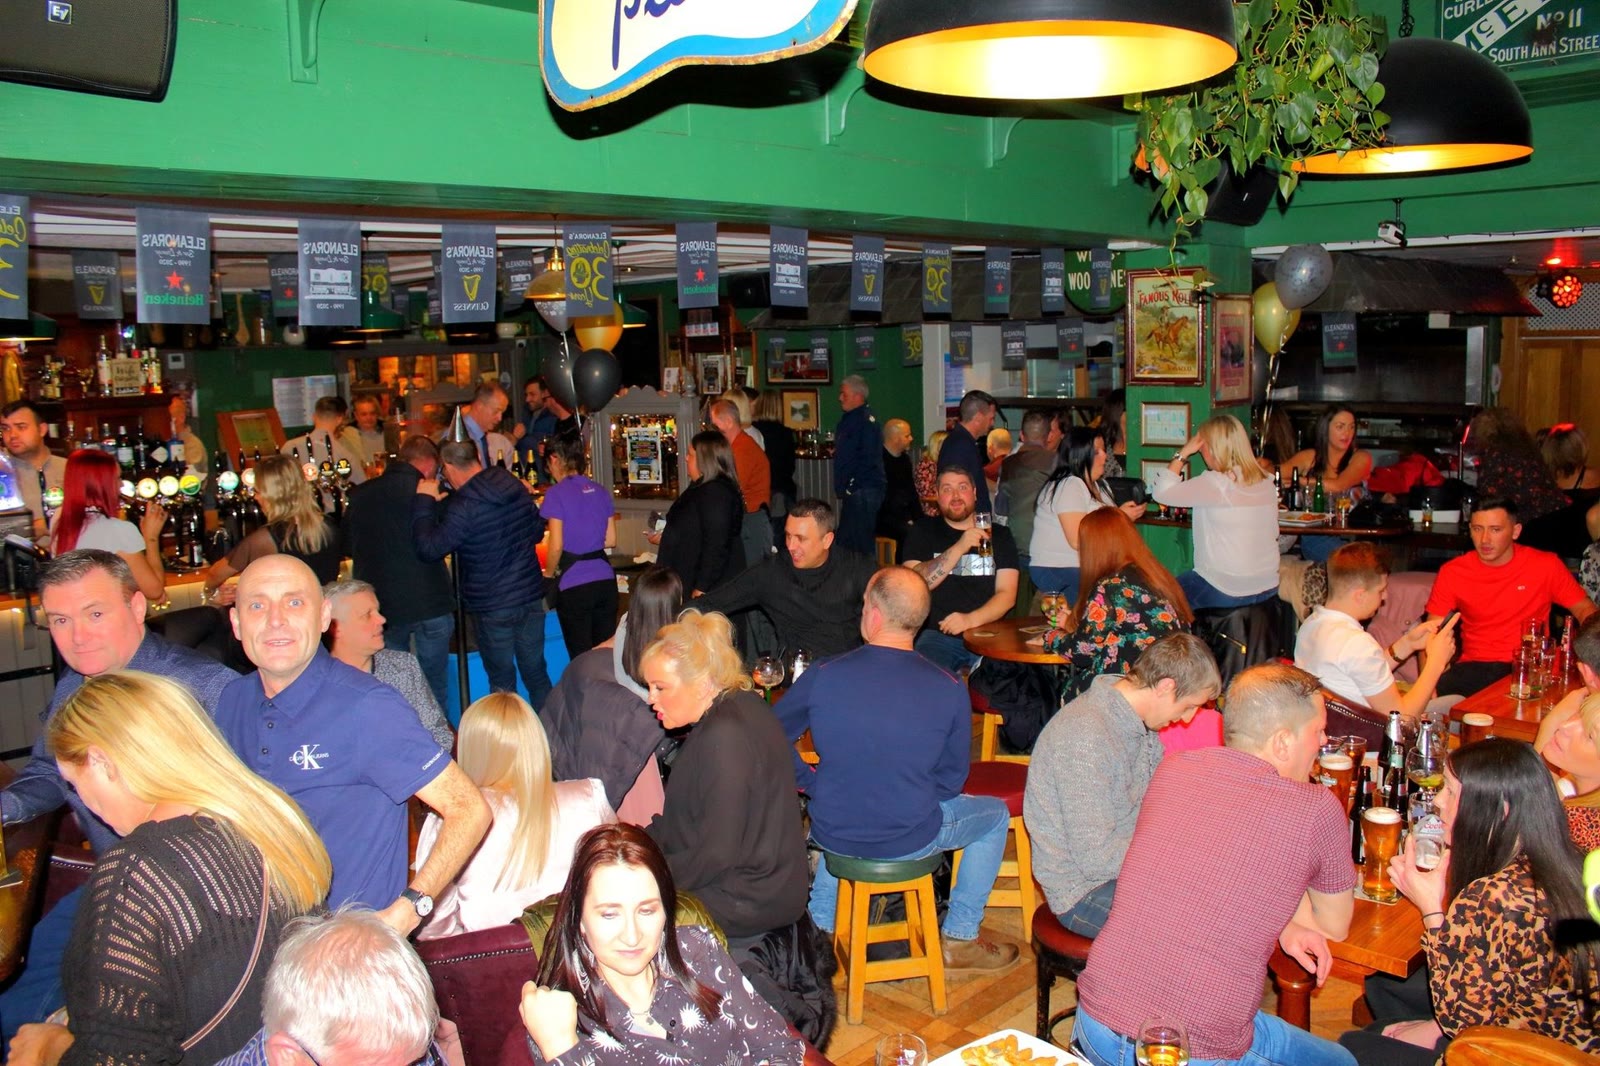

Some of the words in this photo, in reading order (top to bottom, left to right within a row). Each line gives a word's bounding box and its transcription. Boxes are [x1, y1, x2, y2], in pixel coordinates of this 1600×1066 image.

[1488, 45, 1528, 63] SOUTH
[1531, 40, 1556, 58] ANN
[1138, 290, 1170, 305] FAMOUS
